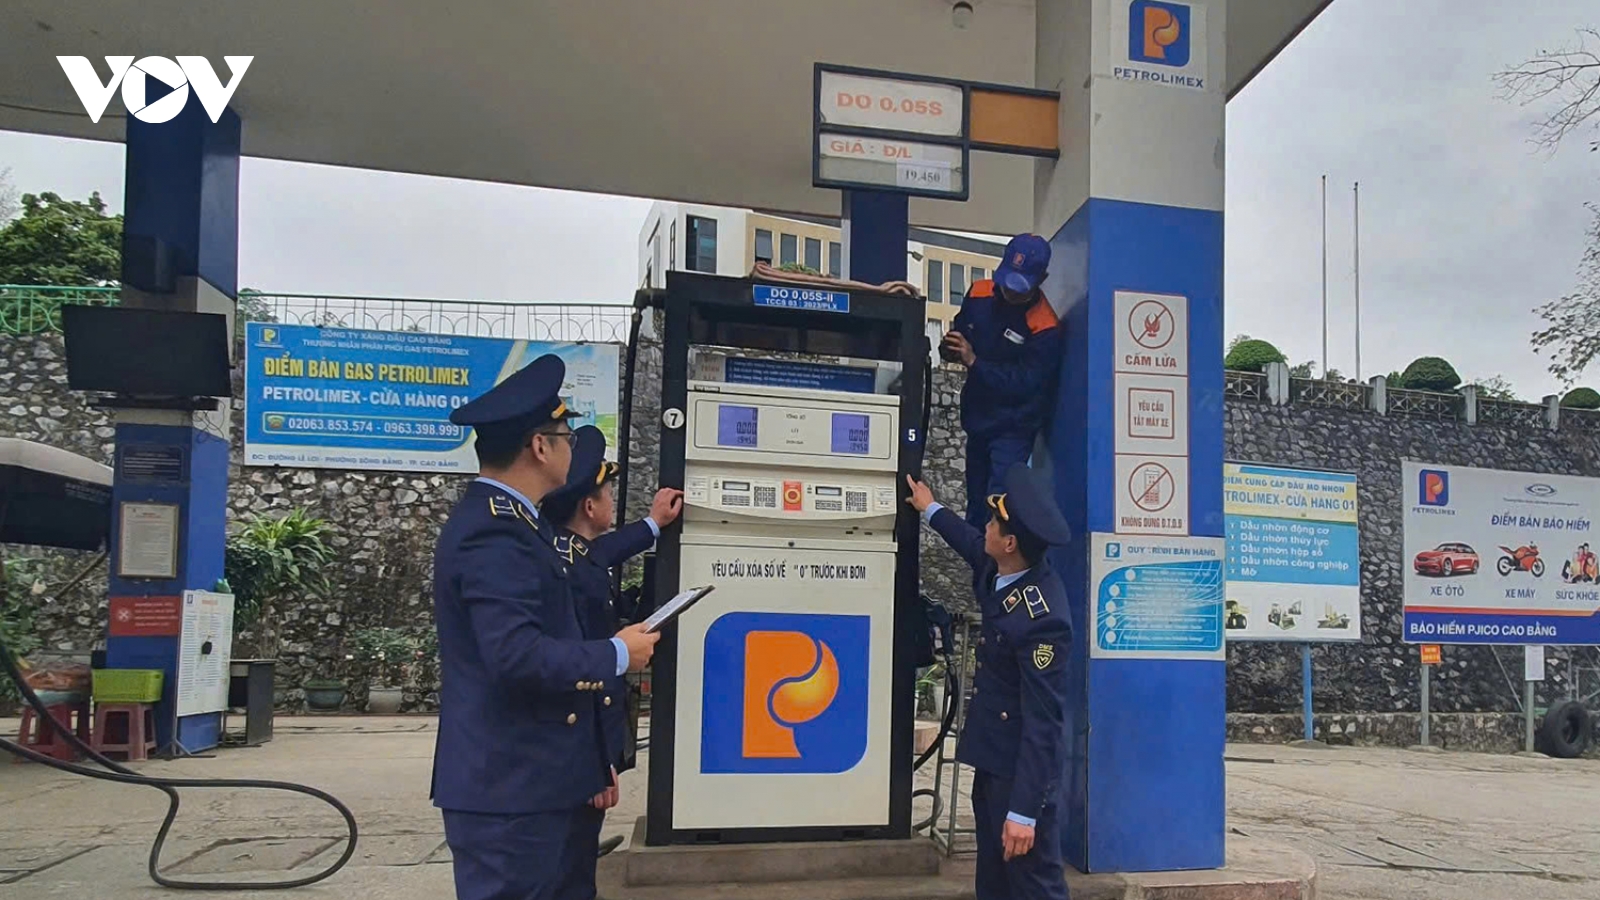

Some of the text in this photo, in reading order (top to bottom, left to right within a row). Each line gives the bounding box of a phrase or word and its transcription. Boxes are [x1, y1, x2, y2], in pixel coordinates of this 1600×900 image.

[1114, 67, 1203, 88] PETROLIMEX
[837, 92, 872, 109] DO
[905, 169, 940, 182] 19.450
[770, 288, 789, 299] DO
[766, 298, 785, 307] TCCS
[422, 346, 469, 356] PETROLIMEX
[1125, 352, 1177, 367] CẤM LỬA
[264, 351, 304, 377] ĐIỂM
[344, 361, 374, 381] GAS
[379, 363, 469, 386] PETROLIMEX
[405, 391, 447, 408] HÀNG
[669, 412, 679, 426] 7
[289, 418, 373, 432] 02063.853.574
[384, 420, 459, 436] 0963.398.999
[908, 429, 916, 441] 5
[1342, 500, 1355, 510] 01
[1412, 507, 1456, 516] PETROLIMEX
[1240, 521, 1259, 530] Dầu
[1240, 533, 1259, 542] Dầu
[1127, 546, 1145, 554] QUY
[1240, 544, 1259, 553] Dầu
[1241, 556, 1260, 565] Dầu
[711, 559, 727, 577] YÊU
[746, 559, 763, 578] XÓA
[764, 558, 776, 577] SỐ
[810, 561, 835, 579] TRƯỚC
[836, 565, 848, 579] KHI
[850, 565, 866, 580] BƠM
[1431, 586, 1442, 596] XE
[1505, 587, 1536, 599] XE MÁY
[1467, 624, 1500, 636] PJICO
[1502, 625, 1524, 636] CAO
[1526, 622, 1557, 637] BẰNG
